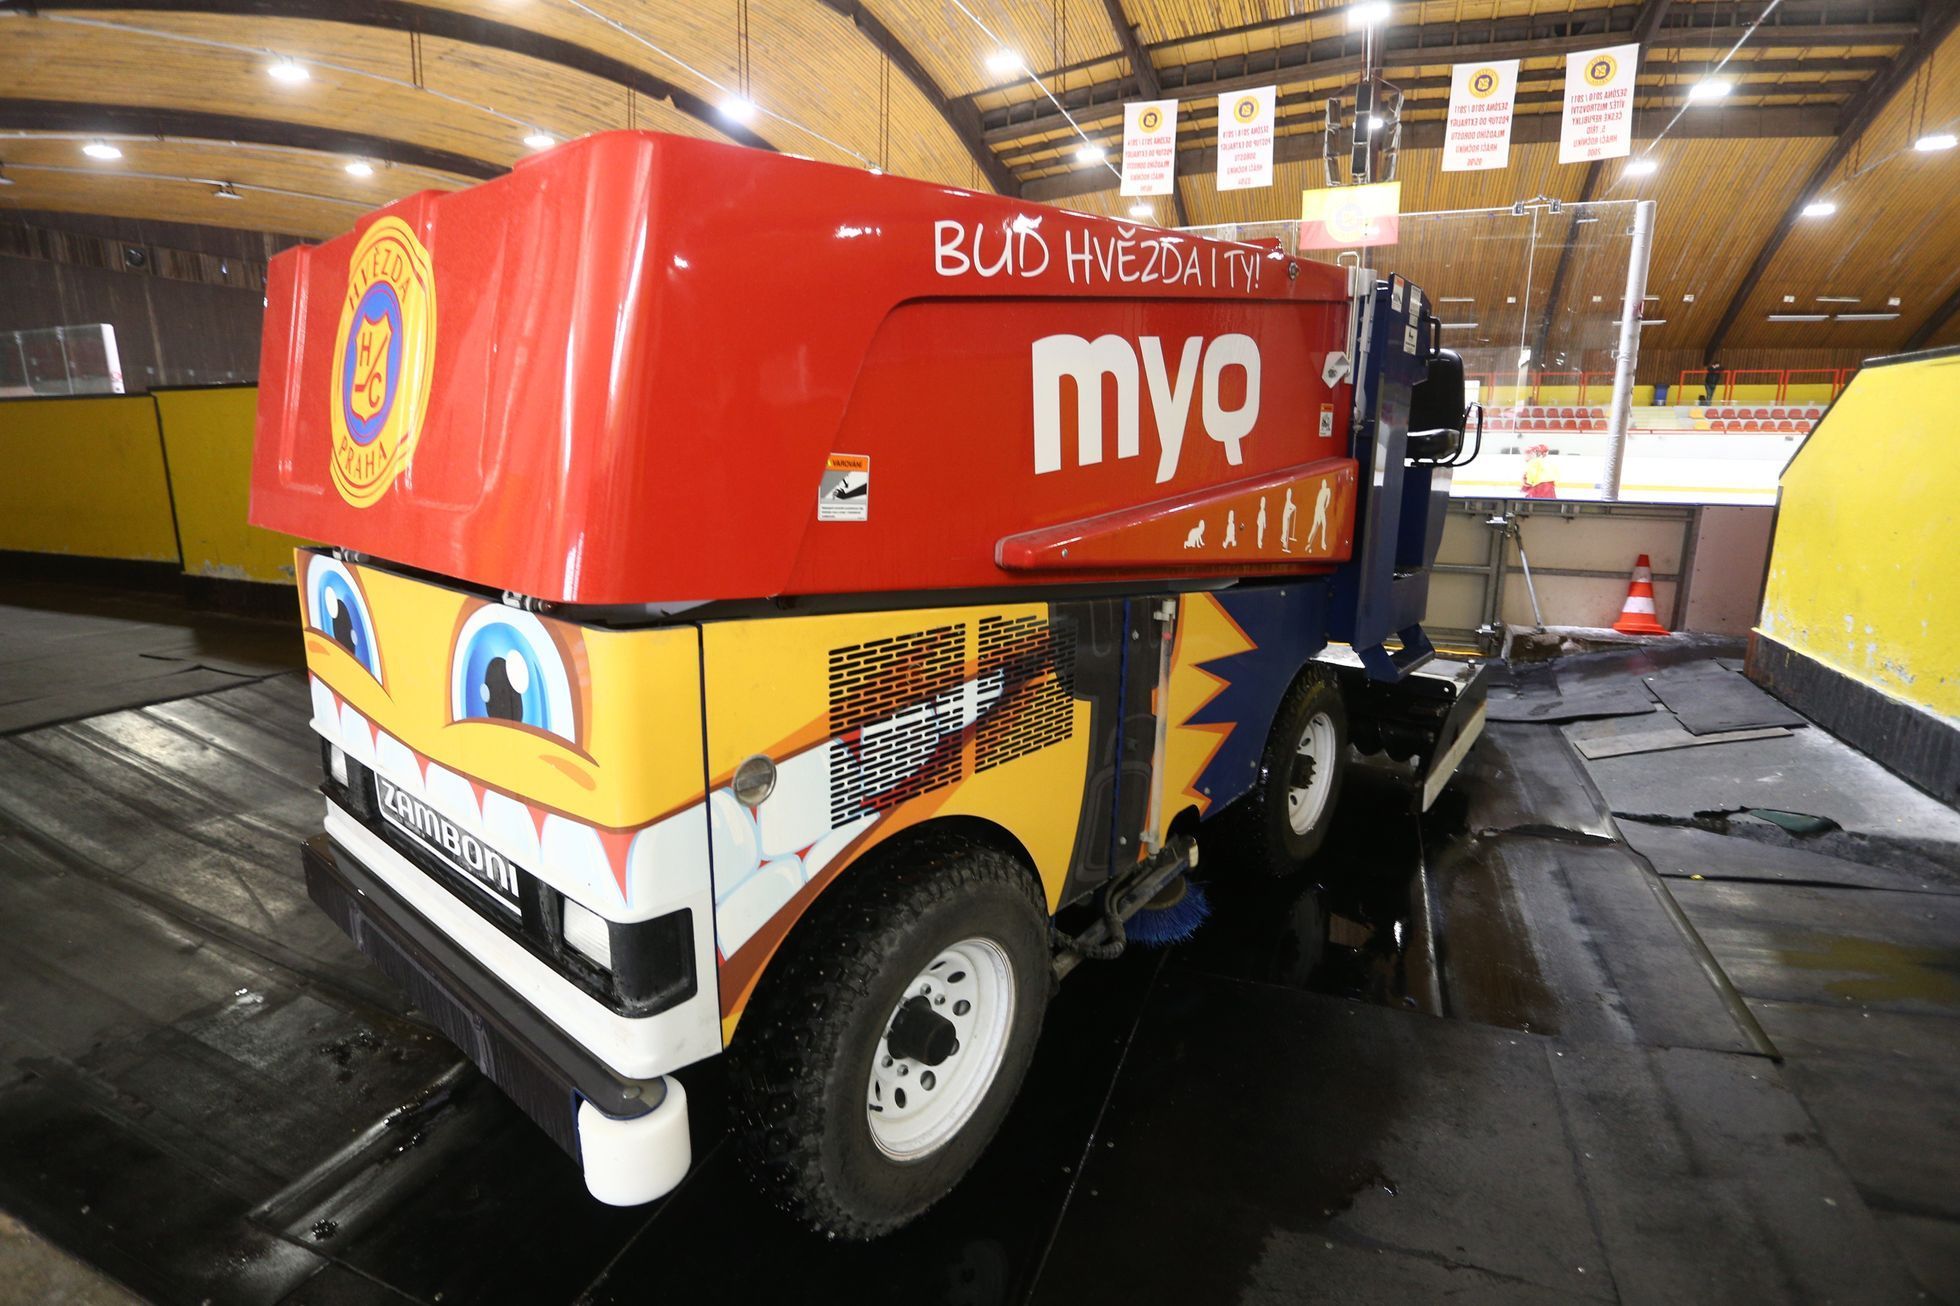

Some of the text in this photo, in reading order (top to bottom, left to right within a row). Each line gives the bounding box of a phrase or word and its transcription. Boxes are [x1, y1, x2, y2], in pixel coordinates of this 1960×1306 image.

[1065, 226, 1202, 286] HVĚZDA
[339, 435, 388, 481] PRAHA
[380, 779, 520, 898] ZAMBONI
